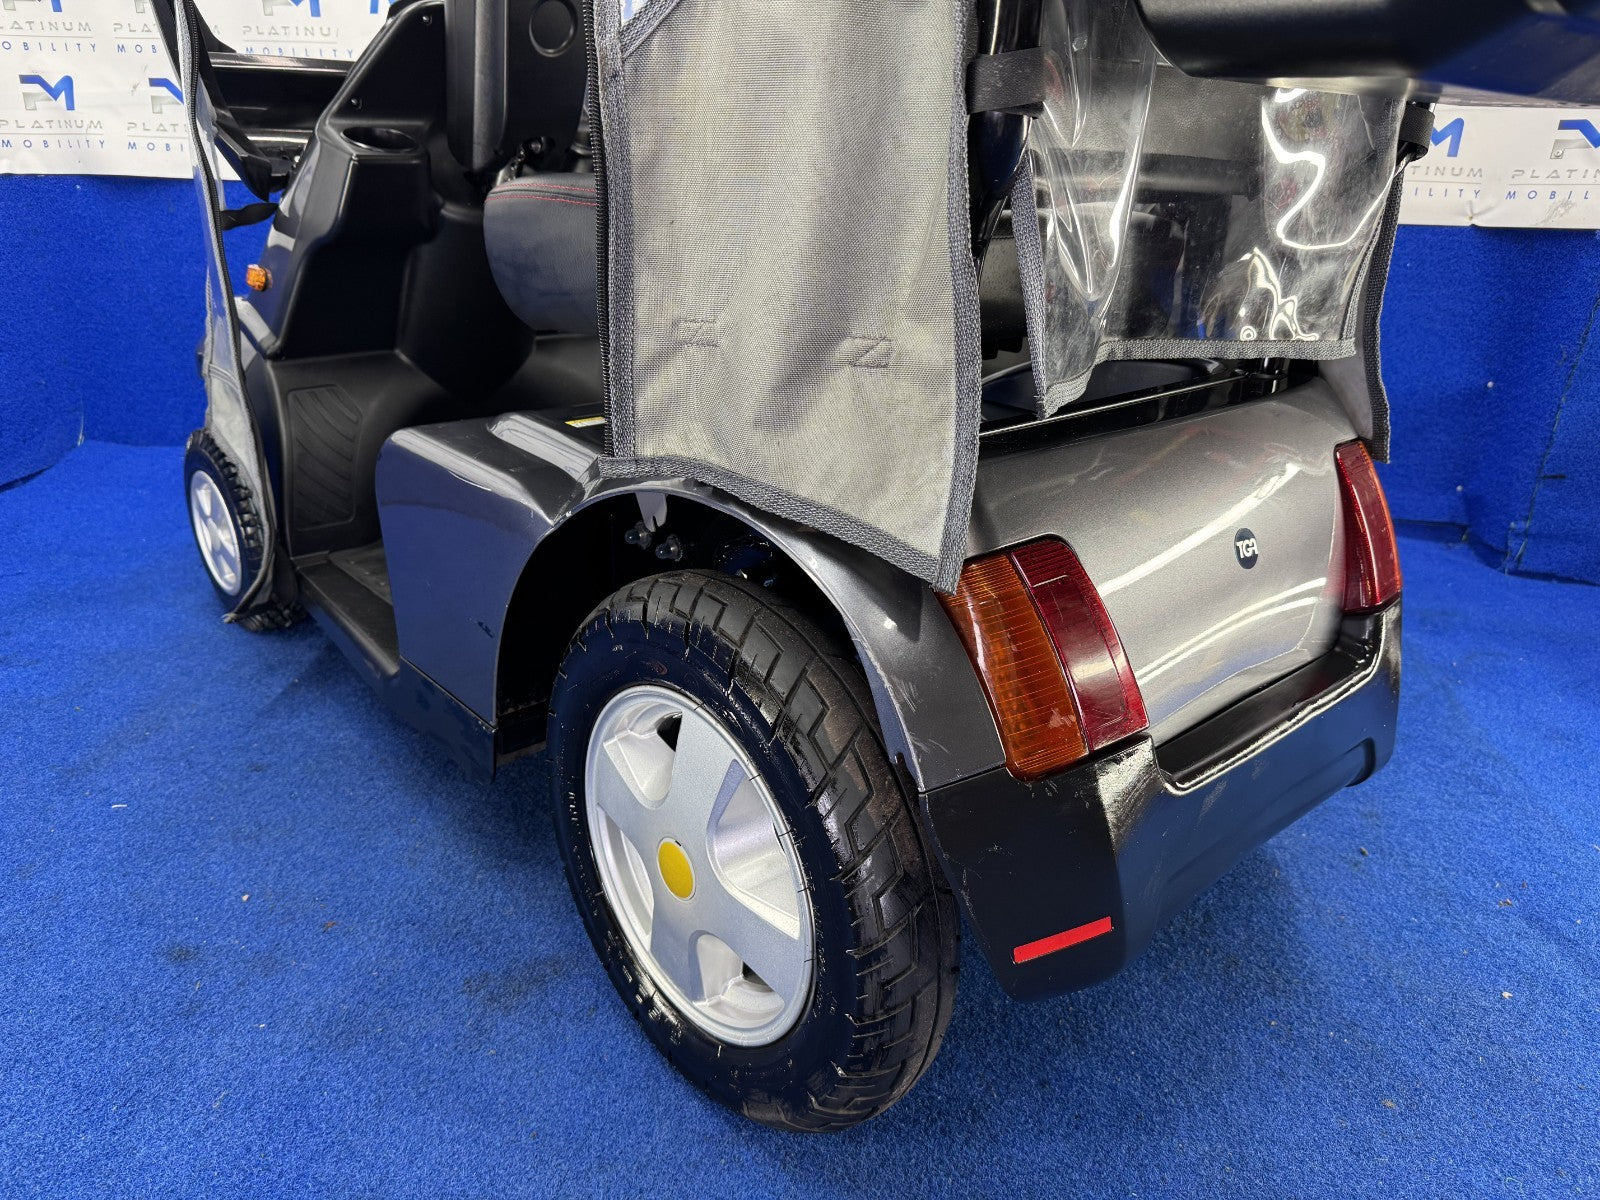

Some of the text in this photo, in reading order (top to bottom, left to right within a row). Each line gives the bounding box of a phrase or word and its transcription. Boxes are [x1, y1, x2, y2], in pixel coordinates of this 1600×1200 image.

[0, 20, 92, 32] ATINUM
[1, 41, 96, 52] OBILITY
[1, 138, 105, 149] MOBILITY
[127, 141, 184, 152] MOBI
[1410, 165, 1483, 178] TINUM
[1511, 168, 1600, 179] PLATIN
[1414, 186, 1481, 199] ILITY
[1505, 189, 1589, 200] MOBIL
[1235, 537, 1259, 559] TGA
